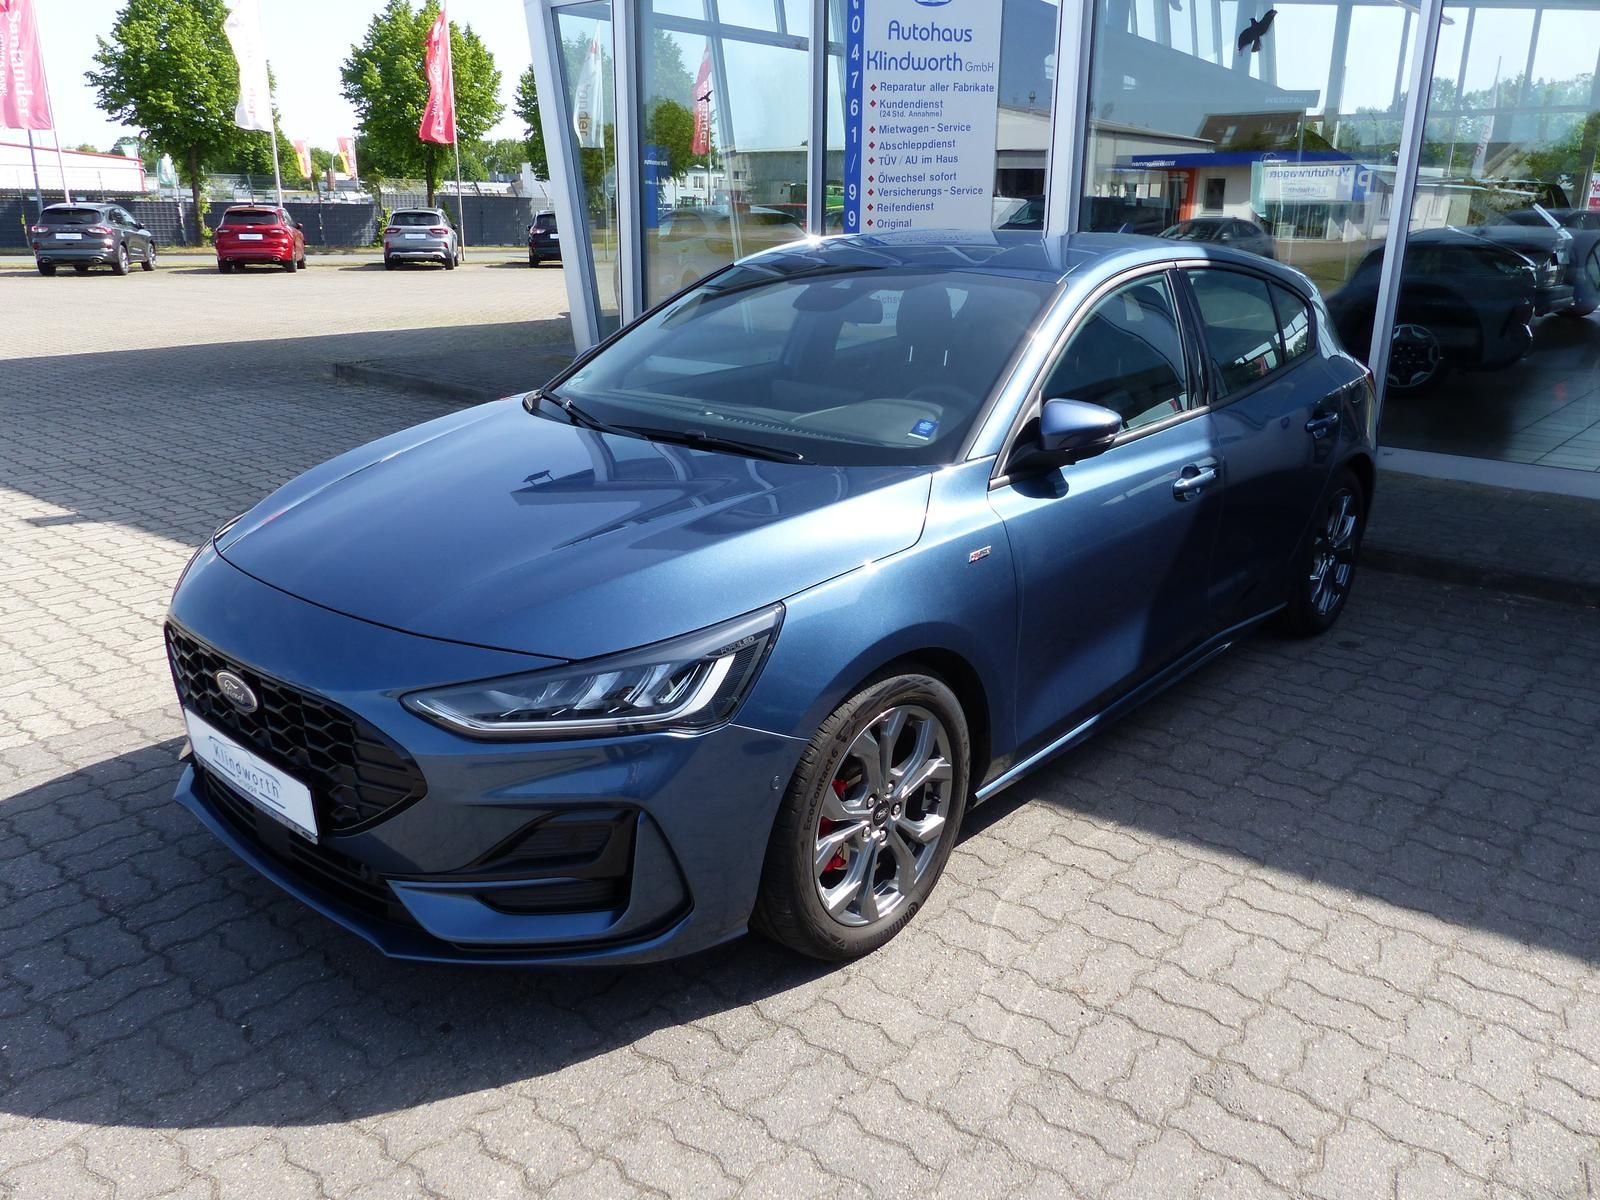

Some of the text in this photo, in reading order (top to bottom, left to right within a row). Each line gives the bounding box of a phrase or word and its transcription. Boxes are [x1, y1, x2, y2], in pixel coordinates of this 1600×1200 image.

[887, 19, 973, 43] Autohaus
[866, 50, 994, 73] Klindworth GmbH
[879, 82, 995, 93] Reparatur aller Fabrikate
[879, 100, 943, 109] Kundendienst
[908, 110, 943, 118] Annahme)
[878, 139, 956, 152] Abschleppdienst
[921, 155, 933, 164] im
[935, 154, 959, 164] Haus
[878, 171, 957, 183] Ölwechsel sofort
[877, 203, 934, 213] Reifendienst
[876, 218, 912, 231] Original
[223, 679, 245, 703] Ford
[213, 744, 280, 798] Klindworth
